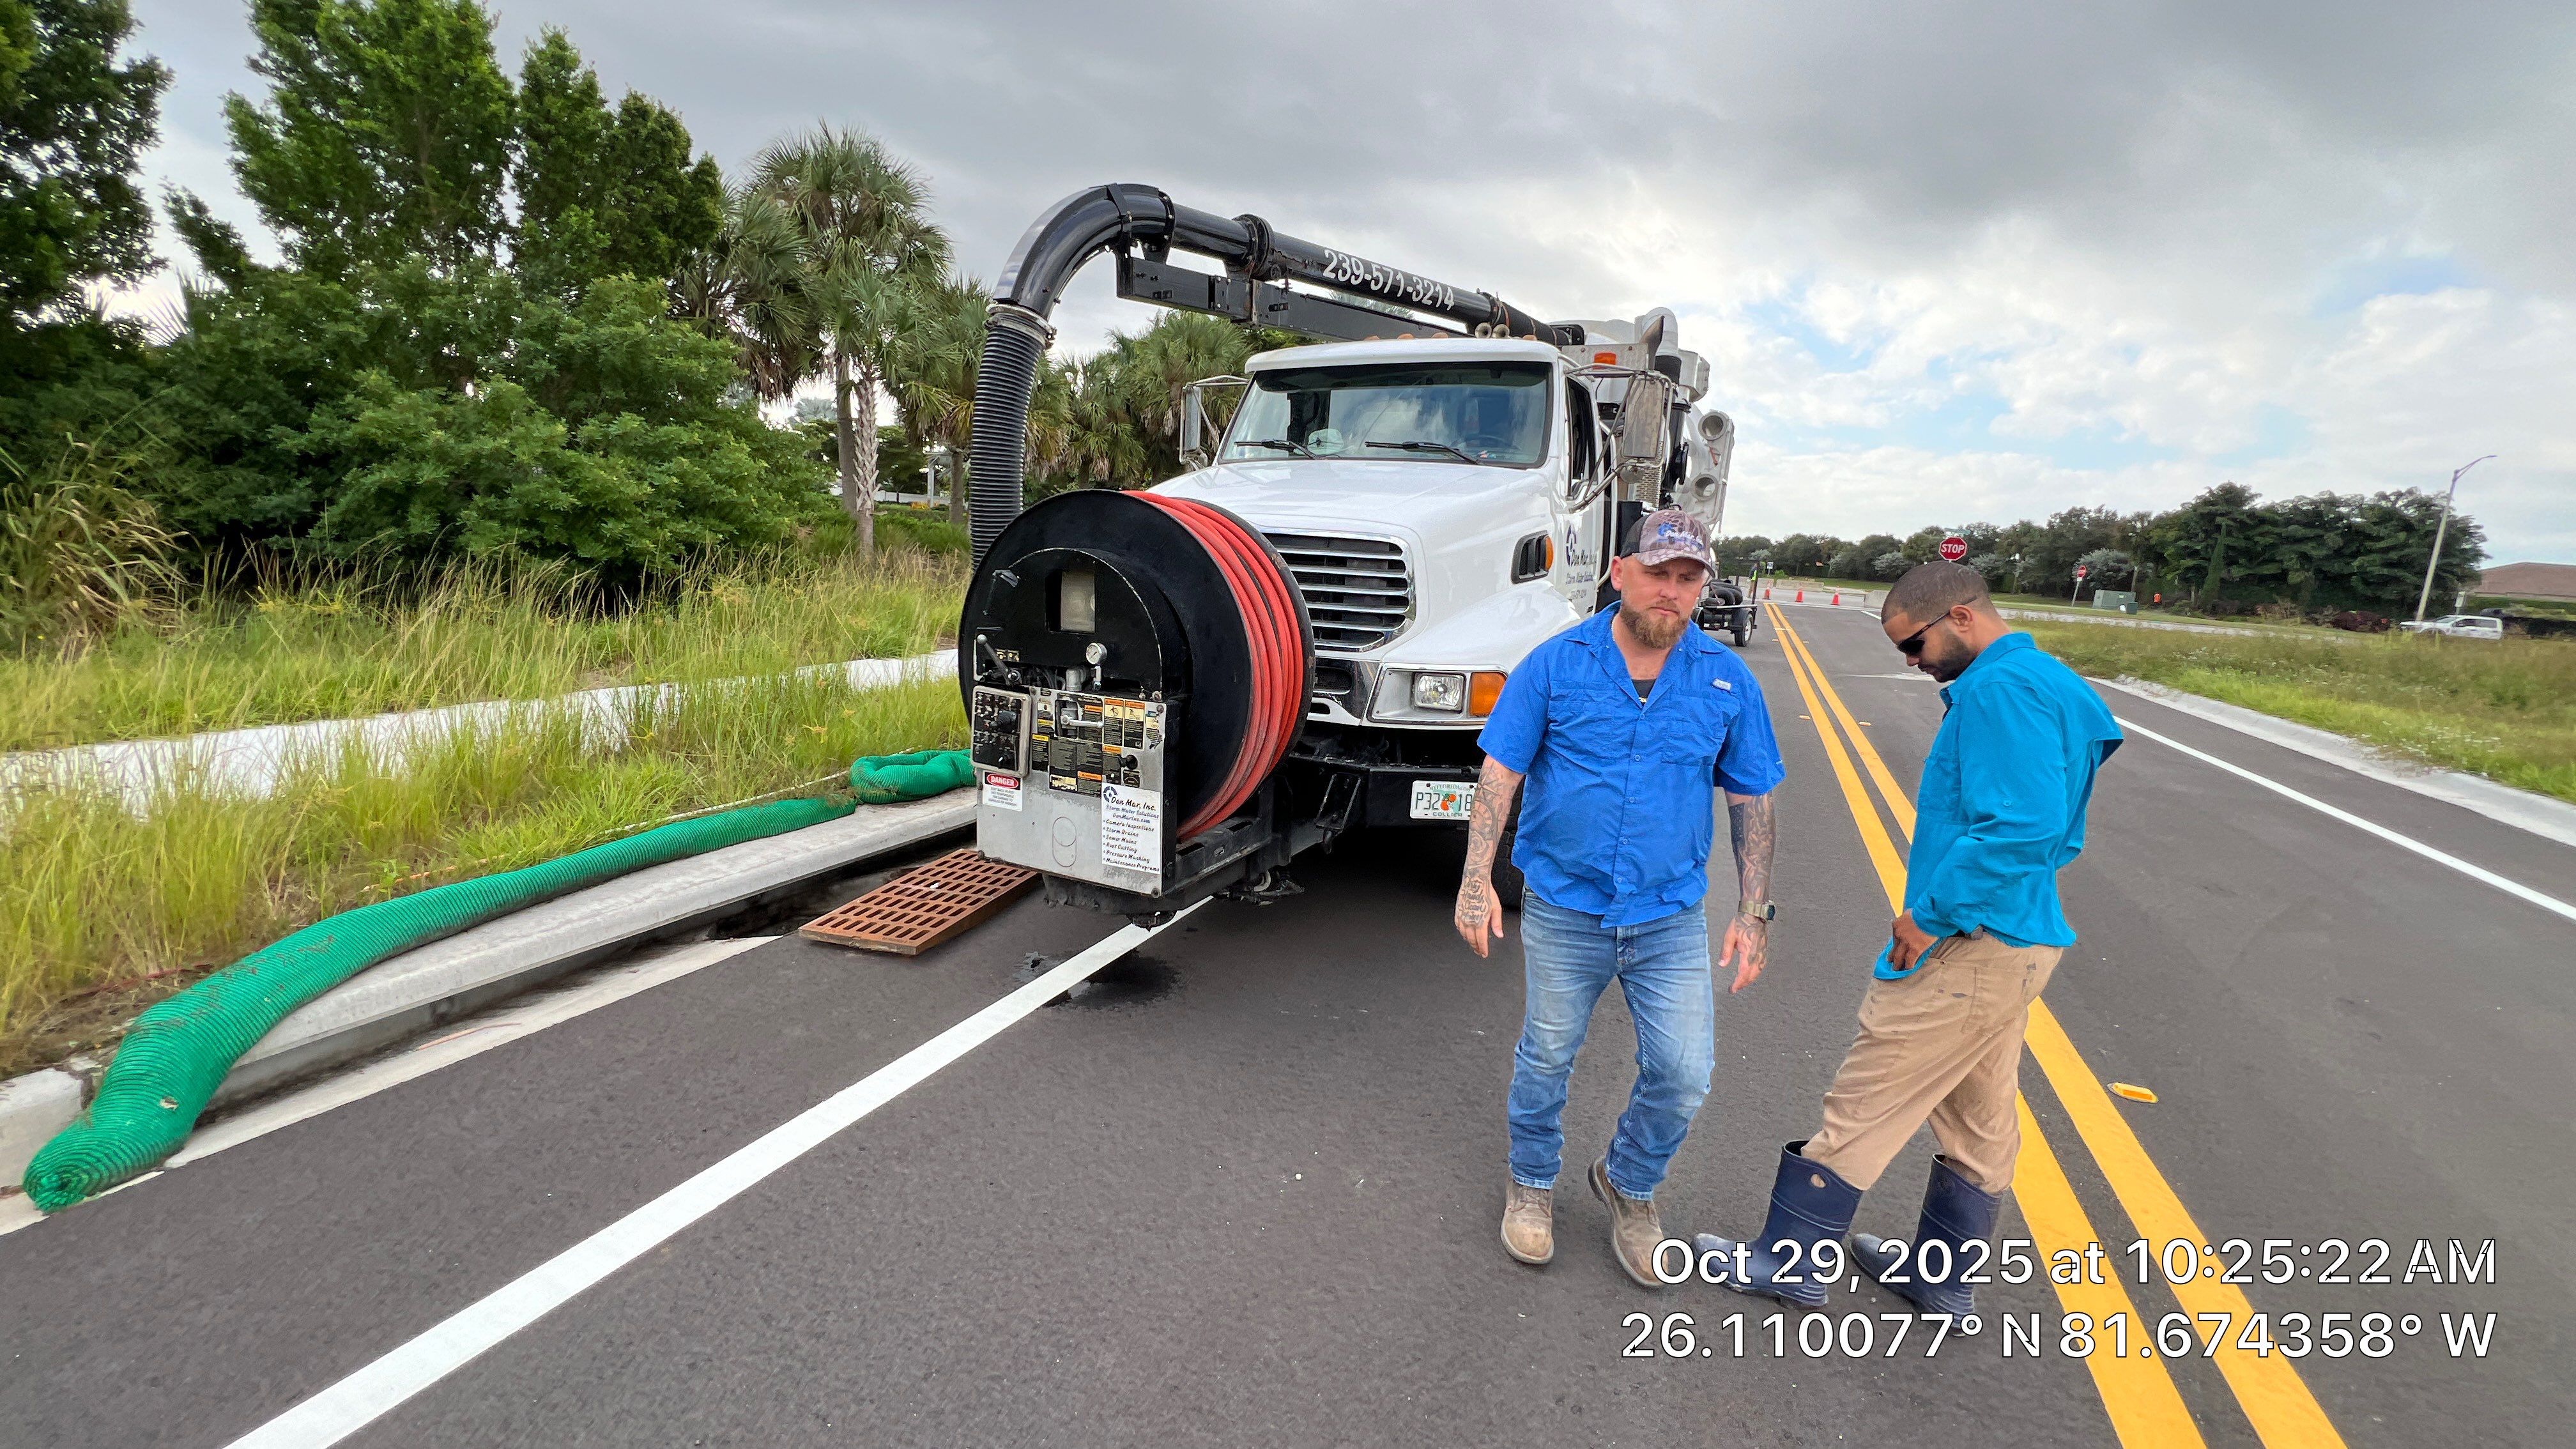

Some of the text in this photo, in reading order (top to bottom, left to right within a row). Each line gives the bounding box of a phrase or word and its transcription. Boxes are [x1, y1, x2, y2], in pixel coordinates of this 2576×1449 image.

[1322, 249, 1455, 311] 239-571-3214
[1941, 544, 1965, 553] STOP
[990, 775, 1015, 786] DANGER
[1111, 796, 1156, 811] Don Mar, Inc.
[1415, 792, 1440, 810] P32
[1136, 809, 1160, 819] Solutions
[1106, 818, 1154, 832] Camera Inspections
[1117, 844, 1137, 854] Cutting
[1106, 850, 1150, 864] Pressure Washing
[1105, 858, 1160, 871] Maintenance Programs
